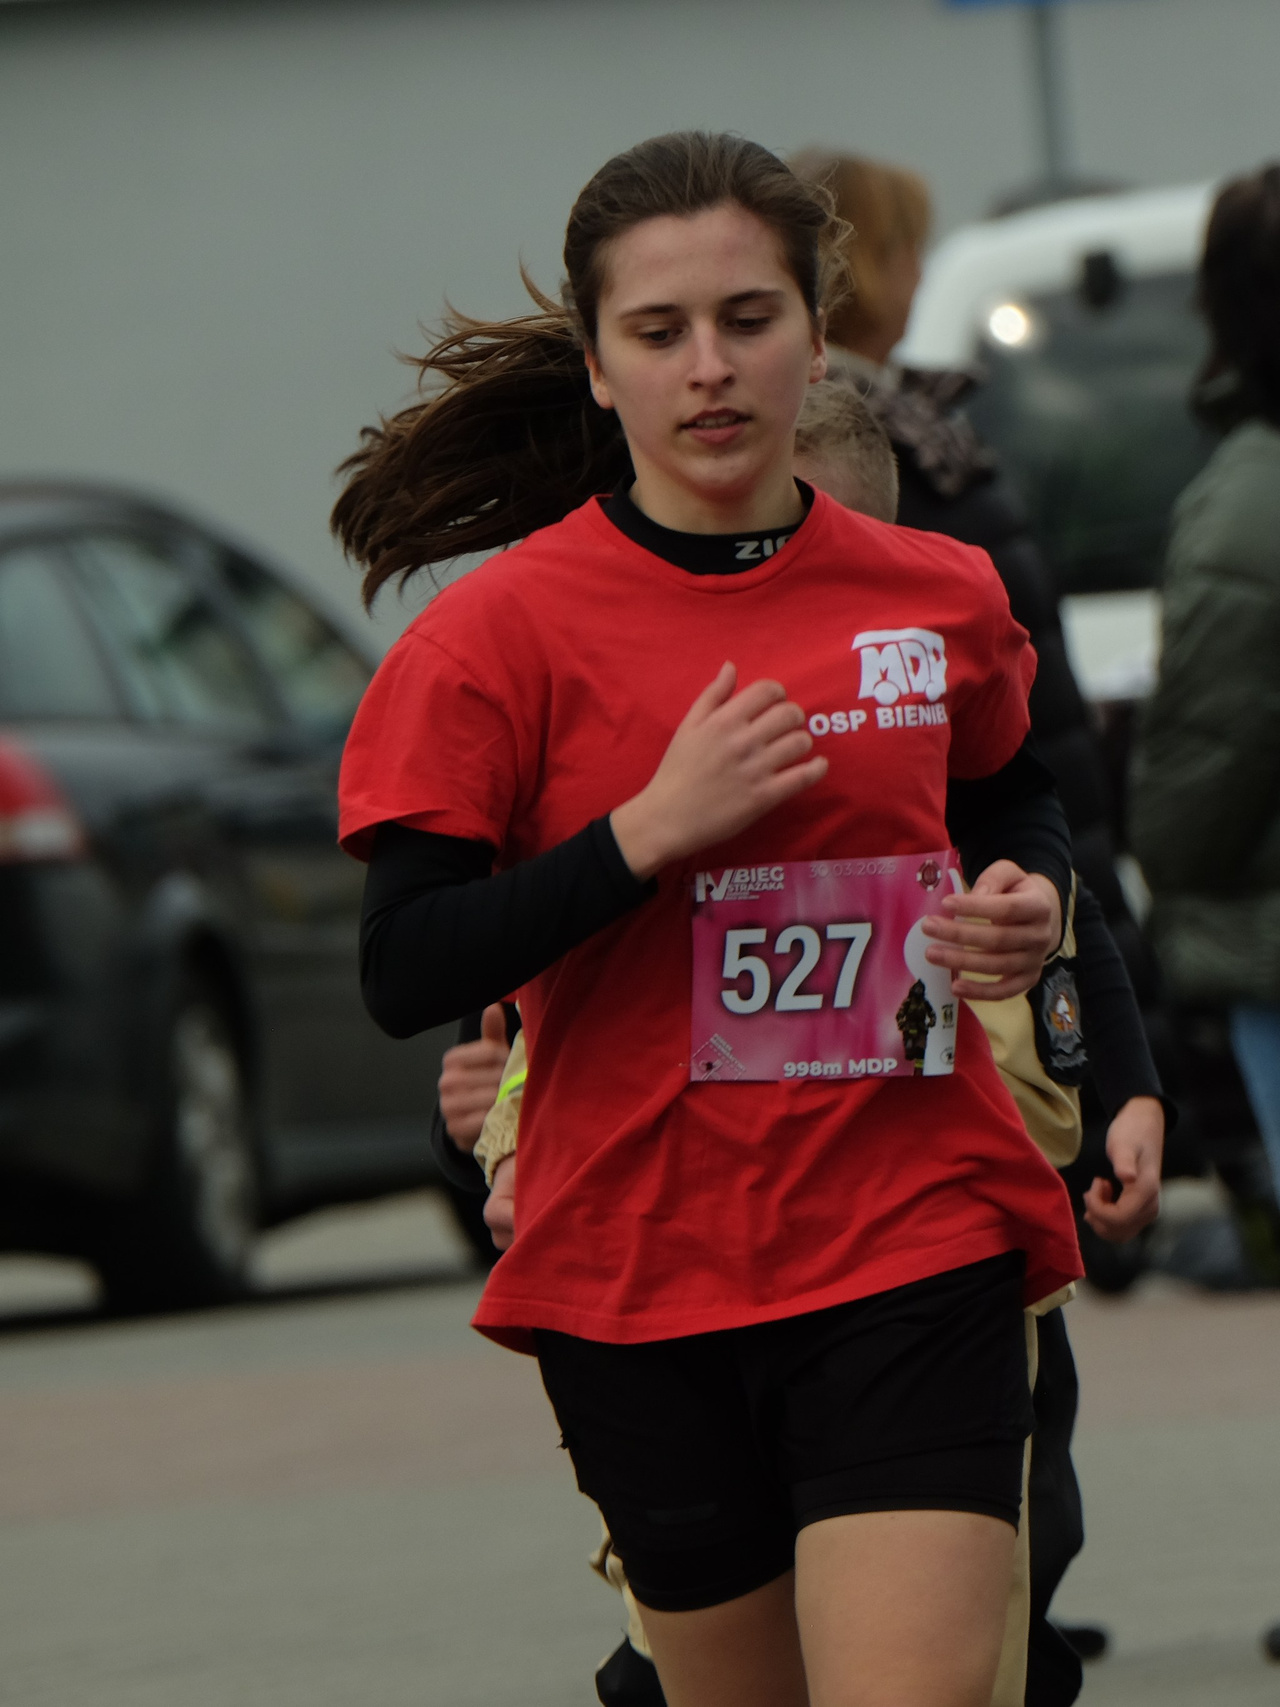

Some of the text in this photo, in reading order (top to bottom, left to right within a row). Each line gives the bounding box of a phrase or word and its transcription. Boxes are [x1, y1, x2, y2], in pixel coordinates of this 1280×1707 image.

[808, 709, 868, 736] OSP
[696, 866, 784, 902] IV BIEG
[721, 922, 873, 1013] 527
[783, 1057, 898, 1078] 998m MDP
